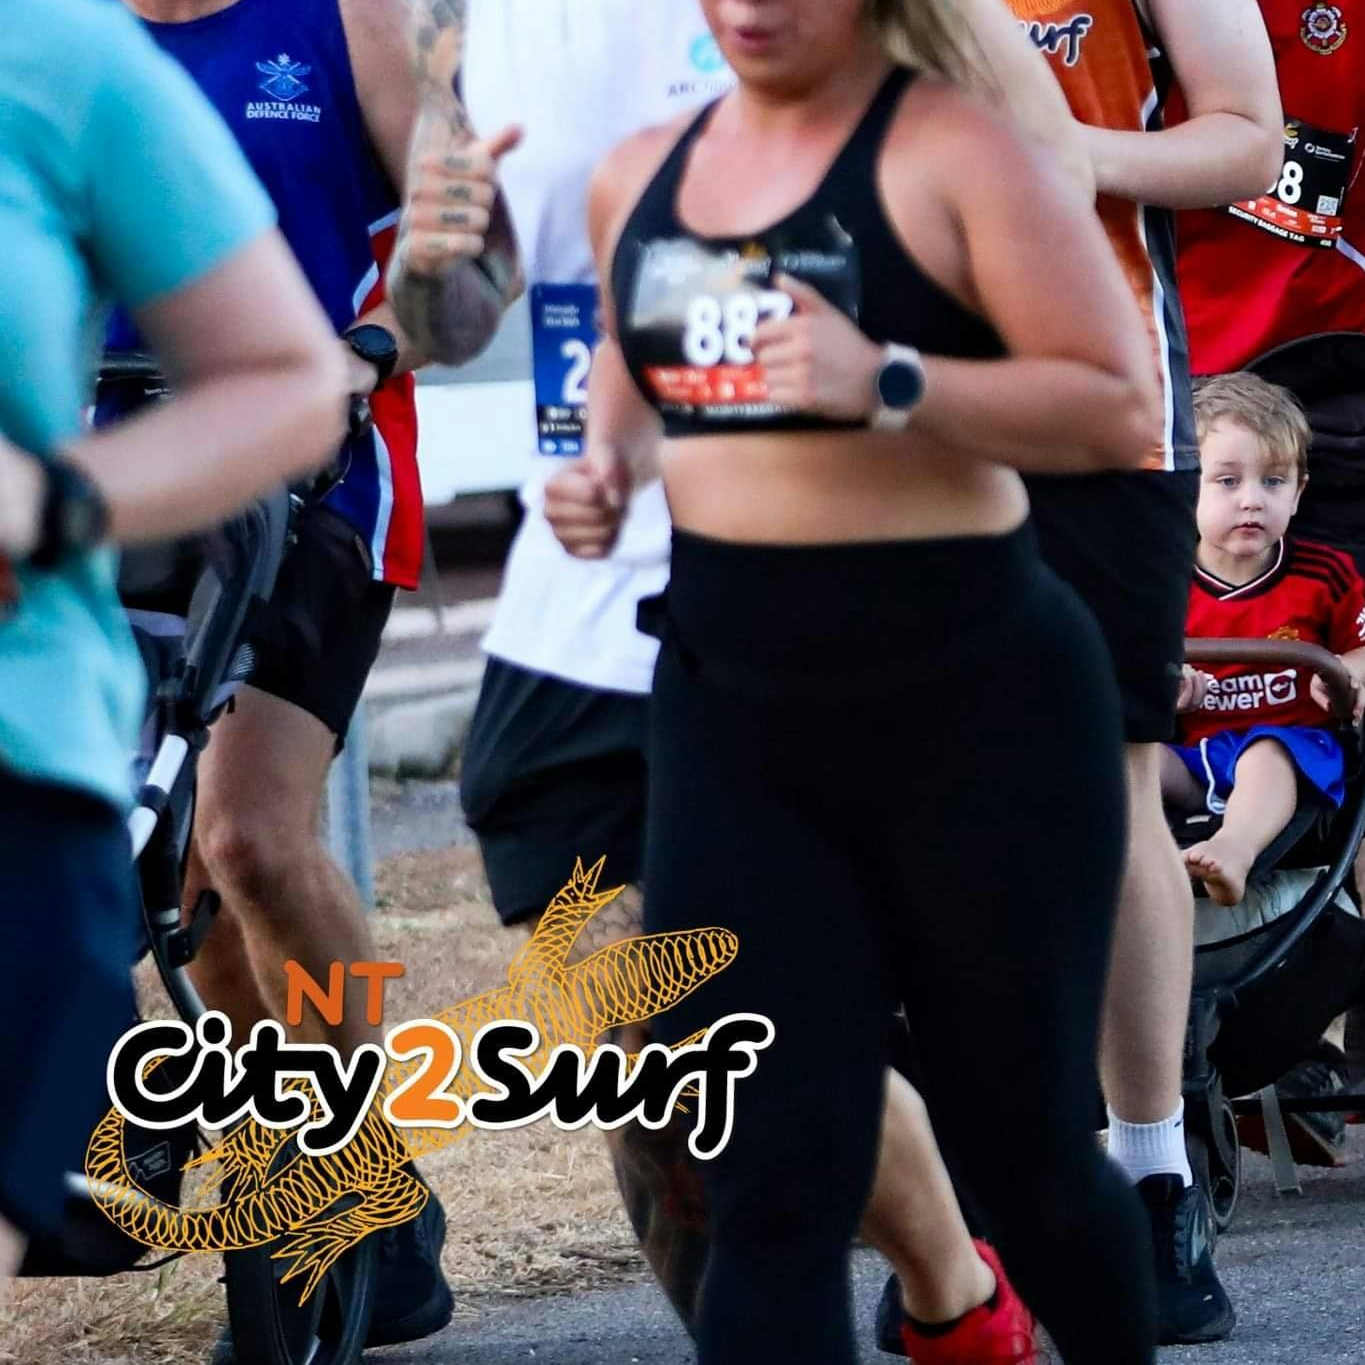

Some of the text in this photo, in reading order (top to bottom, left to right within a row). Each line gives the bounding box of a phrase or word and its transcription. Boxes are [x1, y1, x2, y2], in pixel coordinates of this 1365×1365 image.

[247, 101, 322, 114] AUSTRALIAN
[246, 110, 321, 123] DEFENCE FORCE
[1289, 232, 1305, 242] TAG
[1207, 674, 1264, 694] eam
